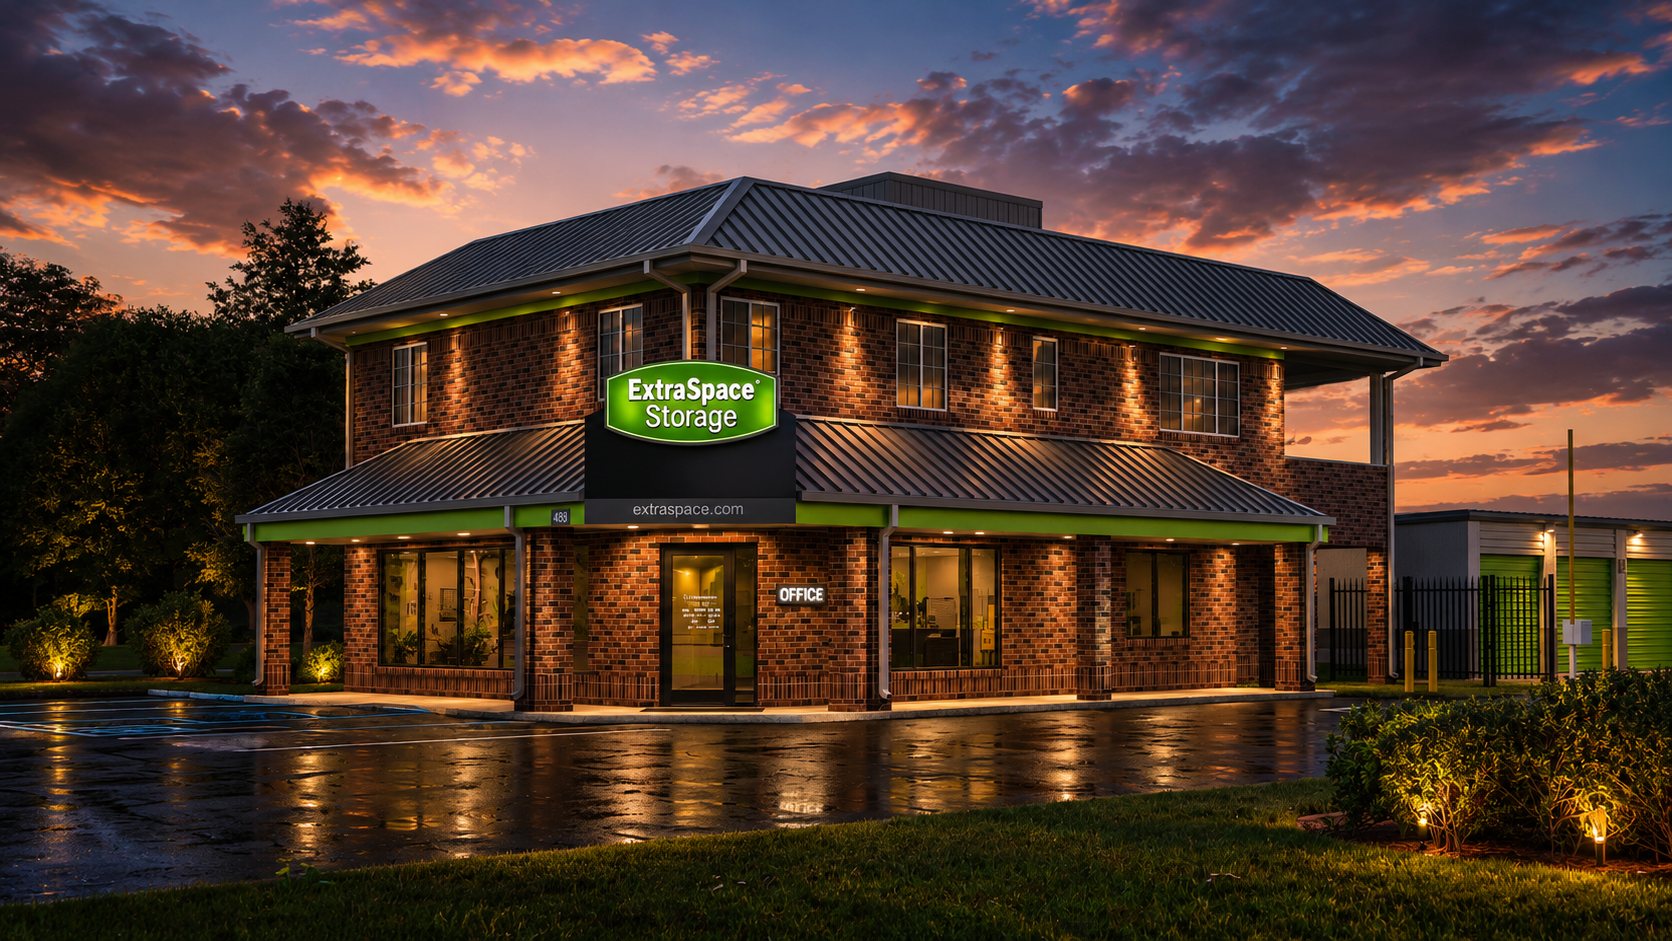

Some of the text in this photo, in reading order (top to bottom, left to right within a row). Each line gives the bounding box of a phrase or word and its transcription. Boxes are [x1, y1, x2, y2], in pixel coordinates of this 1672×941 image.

[628, 377, 755, 406] ExtraSpace
[645, 404, 737, 433] Storage
[633, 503, 744, 518] extraspace.com
[779, 587, 824, 602] OFFICE
